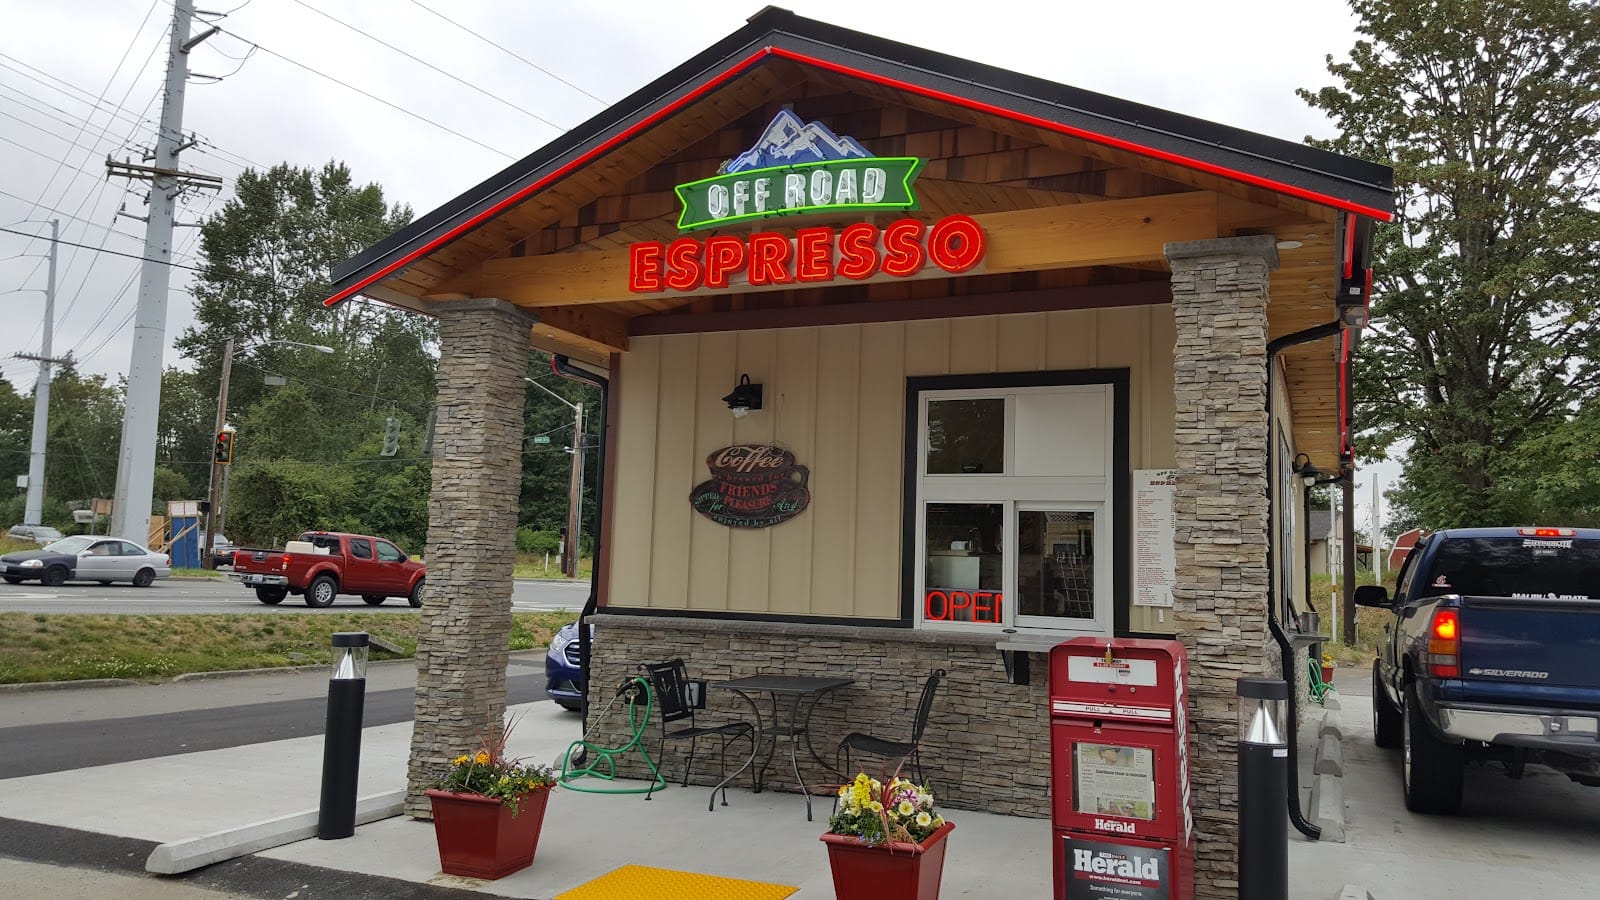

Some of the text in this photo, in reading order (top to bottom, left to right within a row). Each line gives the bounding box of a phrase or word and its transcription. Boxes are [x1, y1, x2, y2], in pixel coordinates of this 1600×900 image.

[708, 167, 888, 218] OFF ROAD
[629, 214, 987, 292] ESPRESSO
[715, 446, 784, 472] Coffee
[720, 483, 778, 497] FRIENDS
[724, 496, 772, 510] PLEASURE
[1482, 668, 1549, 679] SILVERADO
[1094, 818, 1136, 834] Herald
[1073, 848, 1160, 881] Herald
